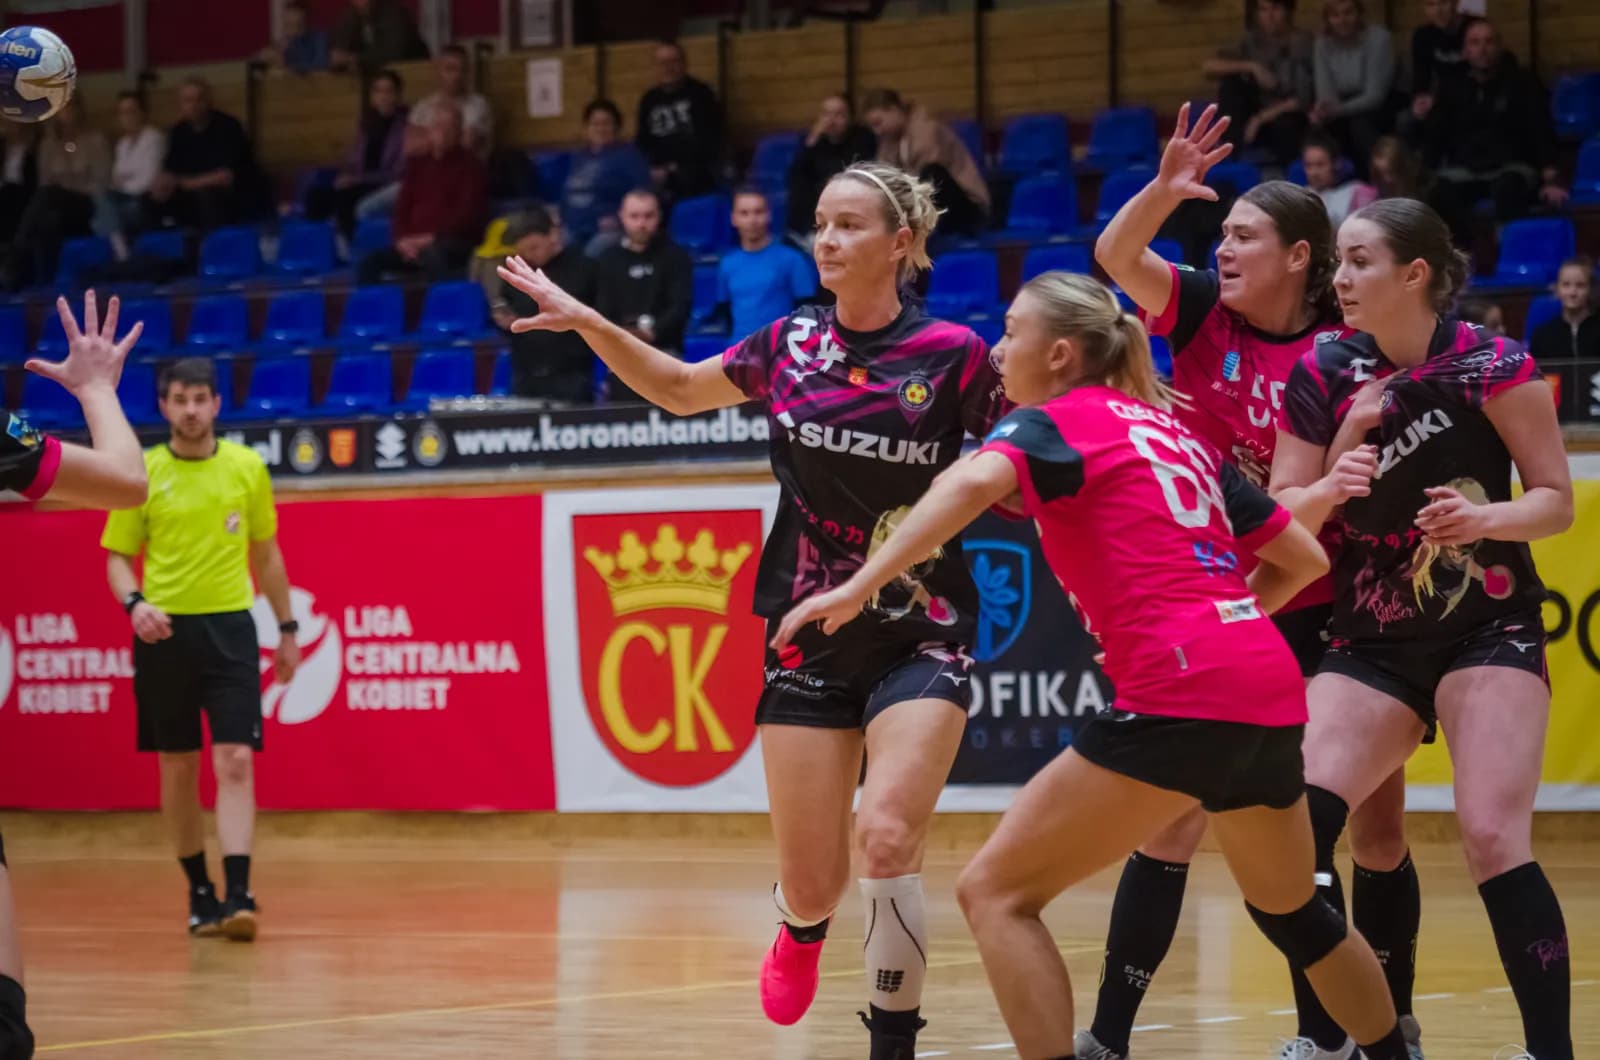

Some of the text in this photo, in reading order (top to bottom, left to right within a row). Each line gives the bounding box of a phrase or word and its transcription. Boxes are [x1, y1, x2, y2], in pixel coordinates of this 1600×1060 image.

[0, 40, 37, 60] lten
[799, 422, 940, 465] SUZUKI
[15, 613, 78, 644] LIGA
[344, 605, 413, 638] LIGA
[17, 647, 136, 679] CENTRAL
[345, 640, 521, 674] CENTRALNA
[18, 682, 113, 714] KOBIET
[346, 678, 451, 711] KOBIET
[598, 621, 735, 754] CK
[877, 984, 900, 994] cep
